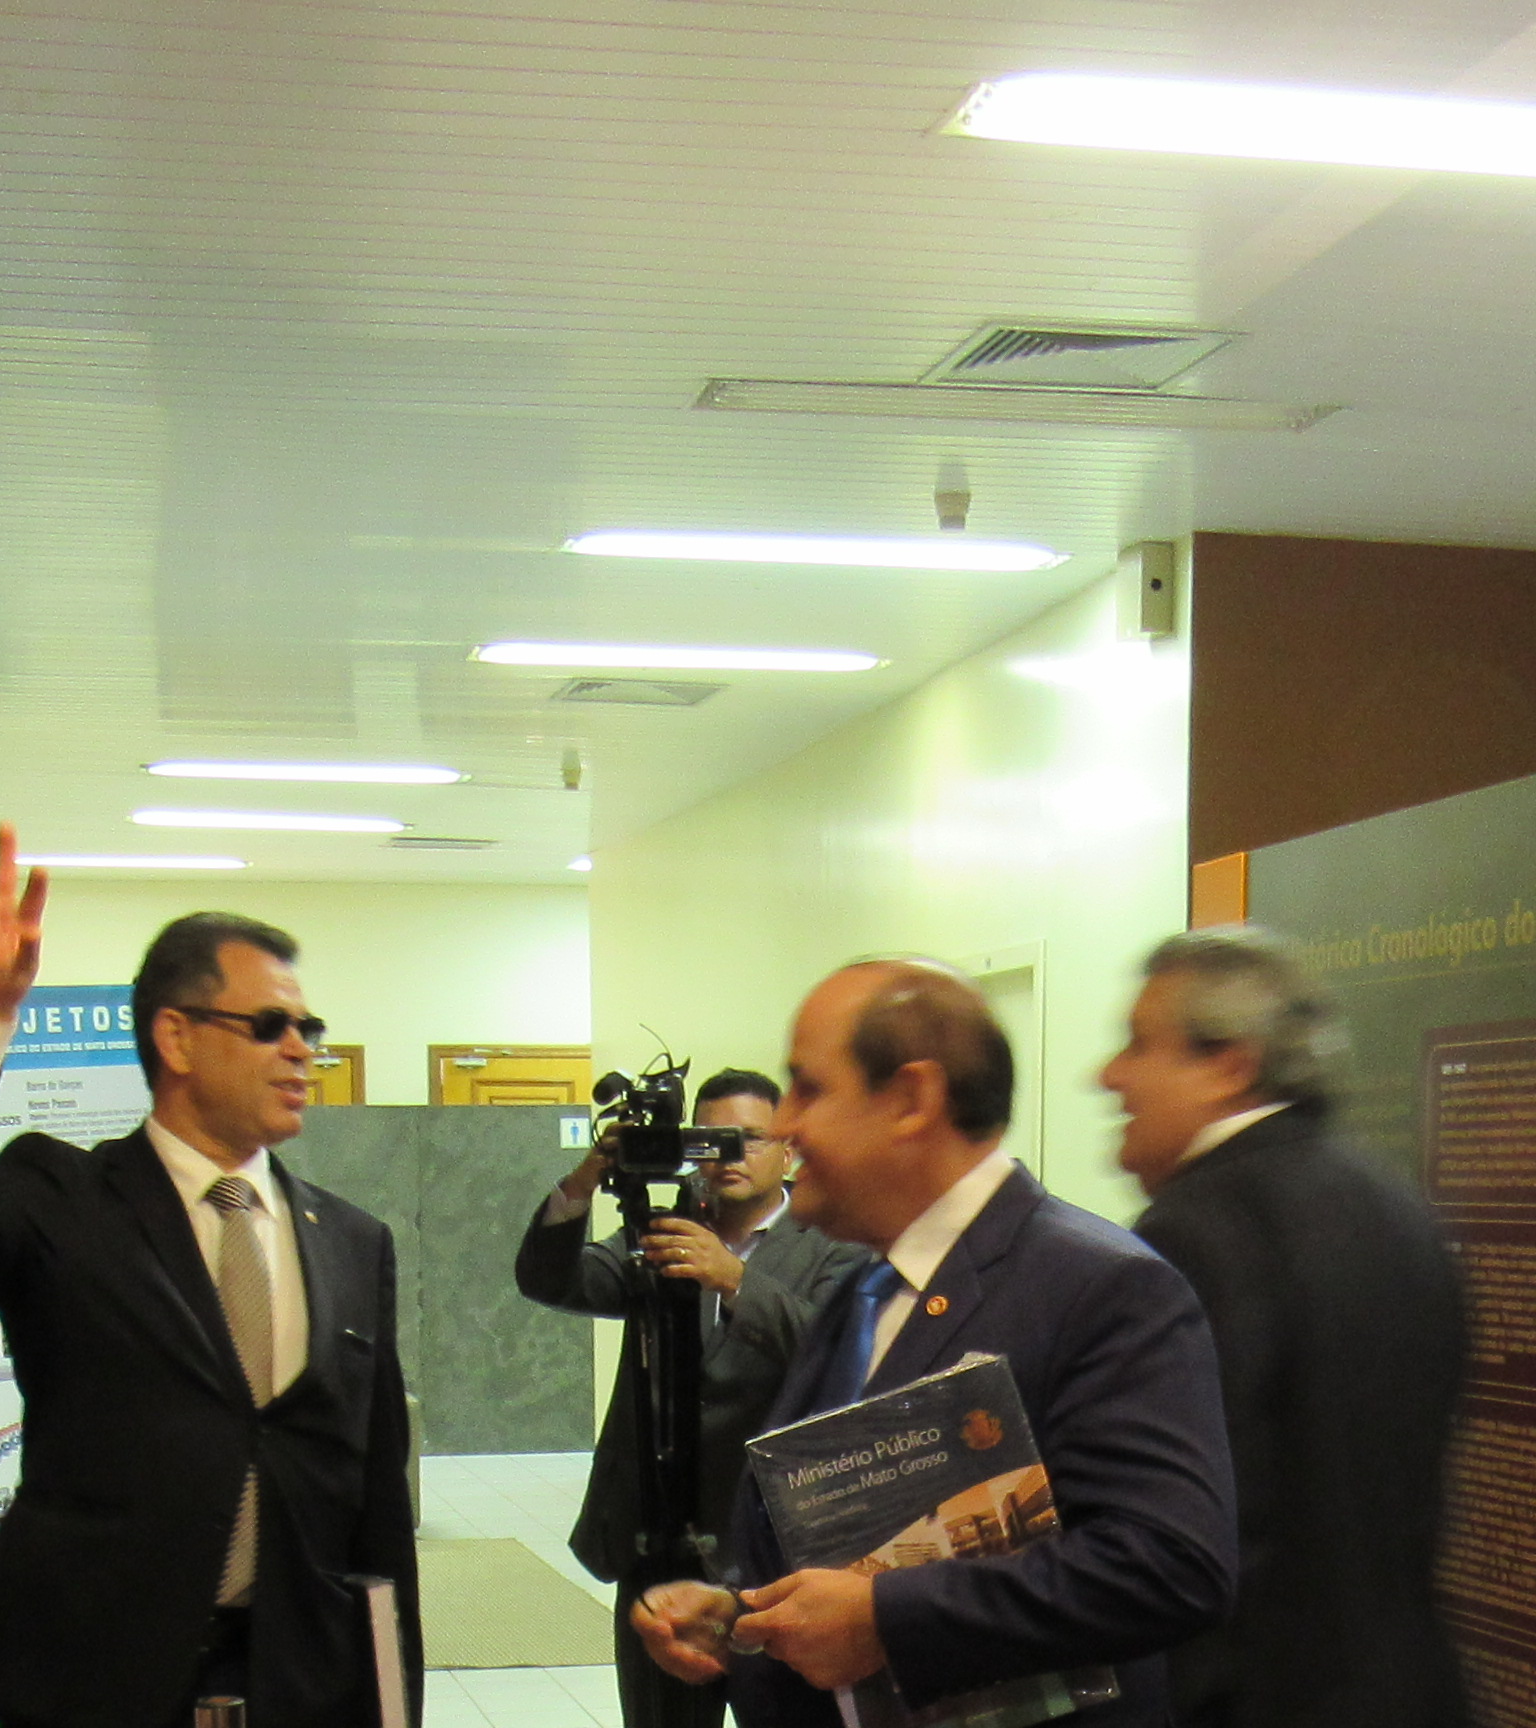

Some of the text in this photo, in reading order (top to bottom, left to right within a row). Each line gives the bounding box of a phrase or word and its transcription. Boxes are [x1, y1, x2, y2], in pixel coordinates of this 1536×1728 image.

[1367, 911, 1497, 967] Cronológico
[1505, 899, 1536, 946] do
[20, 1004, 135, 1035] JETOS
[787, 1428, 941, 1490] Ministério Público
[860, 1467, 897, 1490] Mato
[899, 1451, 949, 1475] Grosso
